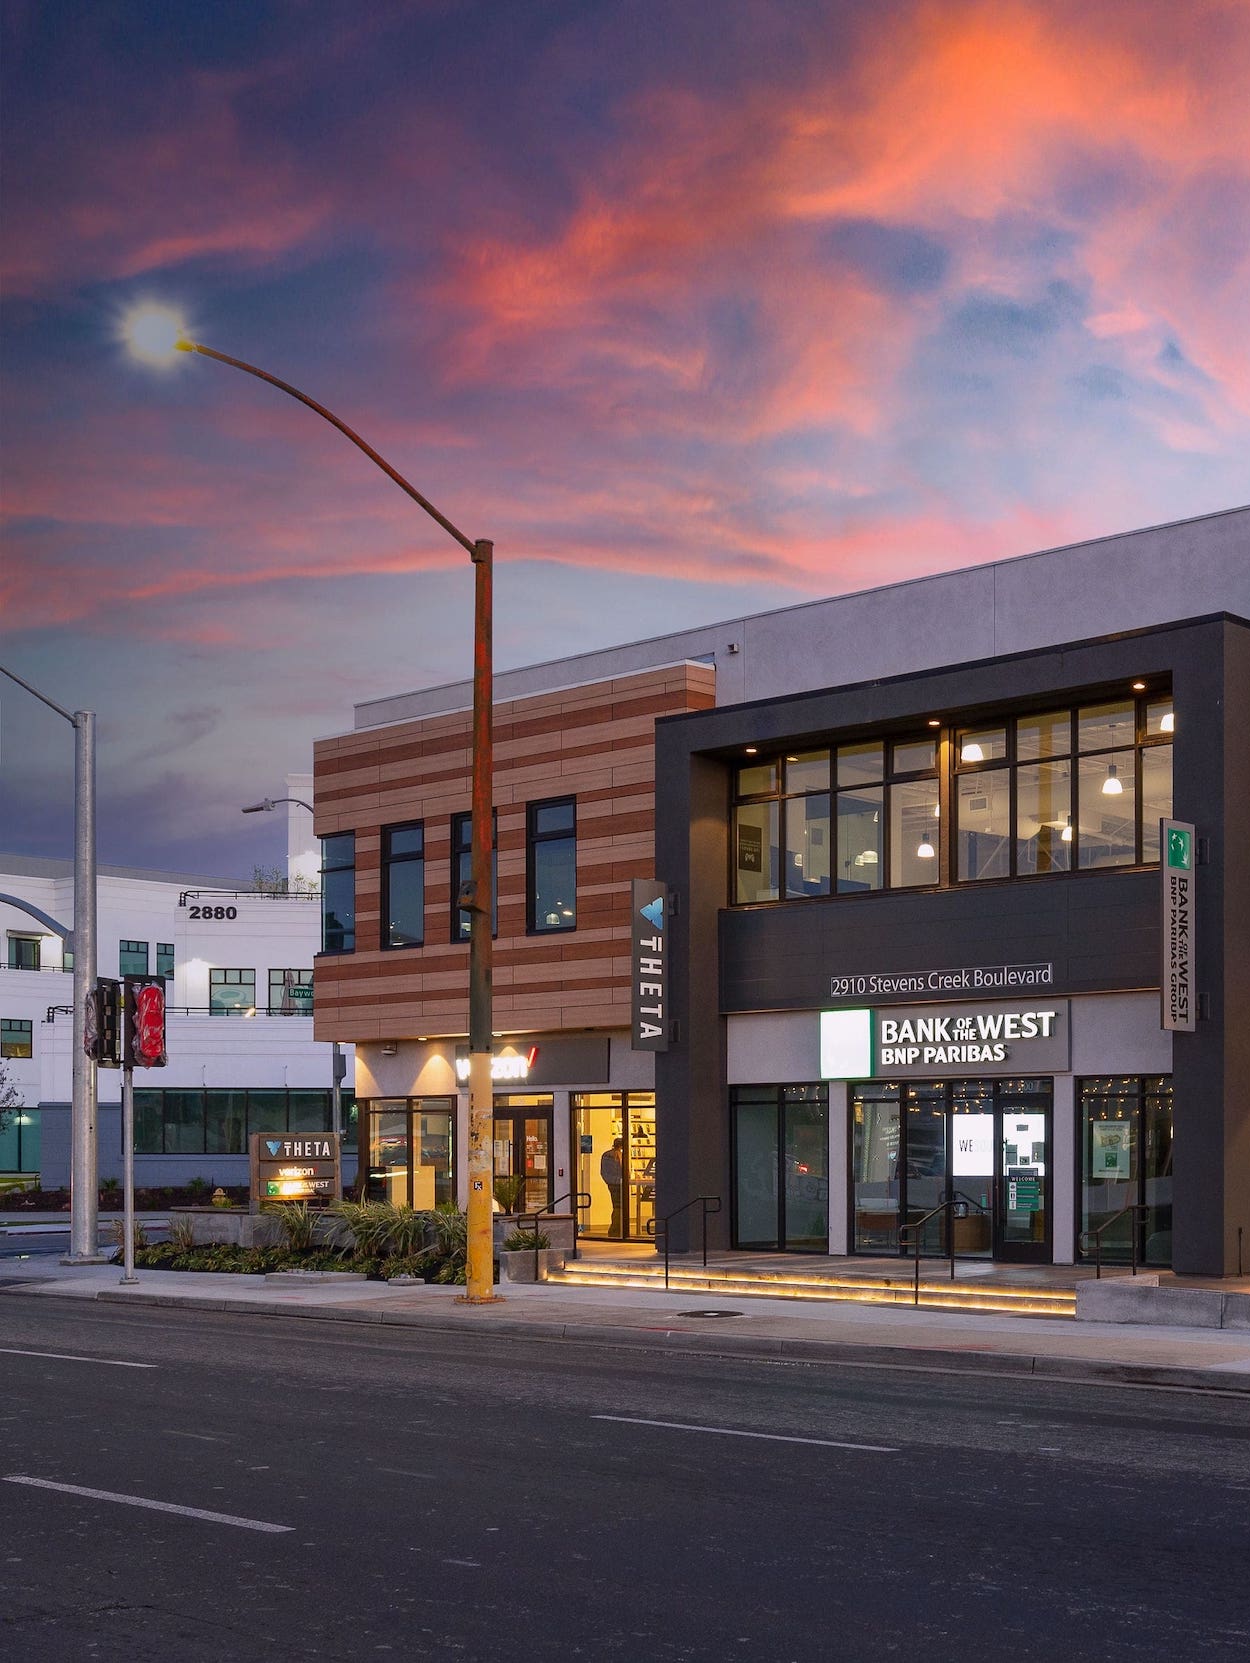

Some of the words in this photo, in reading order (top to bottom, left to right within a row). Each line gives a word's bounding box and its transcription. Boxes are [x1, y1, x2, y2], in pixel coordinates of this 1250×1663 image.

[189, 906, 237, 920] 2880
[1179, 878, 1189, 938] BANK
[640, 936, 663, 1039] THETA
[832, 977, 866, 995] 2910
[869, 974, 924, 993] Stevens
[928, 970, 971, 989] Creek
[974, 964, 1051, 986] Boulevard
[1179, 961, 1189, 1023] WEST
[881, 1018, 951, 1044] BANK
[956, 1017, 973, 1029] OF
[976, 1011, 1055, 1039] WEST
[953, 1029, 977, 1041] THE
[881, 1047, 920, 1065] BNP
[923, 1044, 1006, 1064] PARIBAS
[456, 1055, 529, 1080] vzon
[284, 1141, 331, 1156] THETA
[959, 1139, 974, 1152] WE
[278, 1166, 315, 1176] verizon
